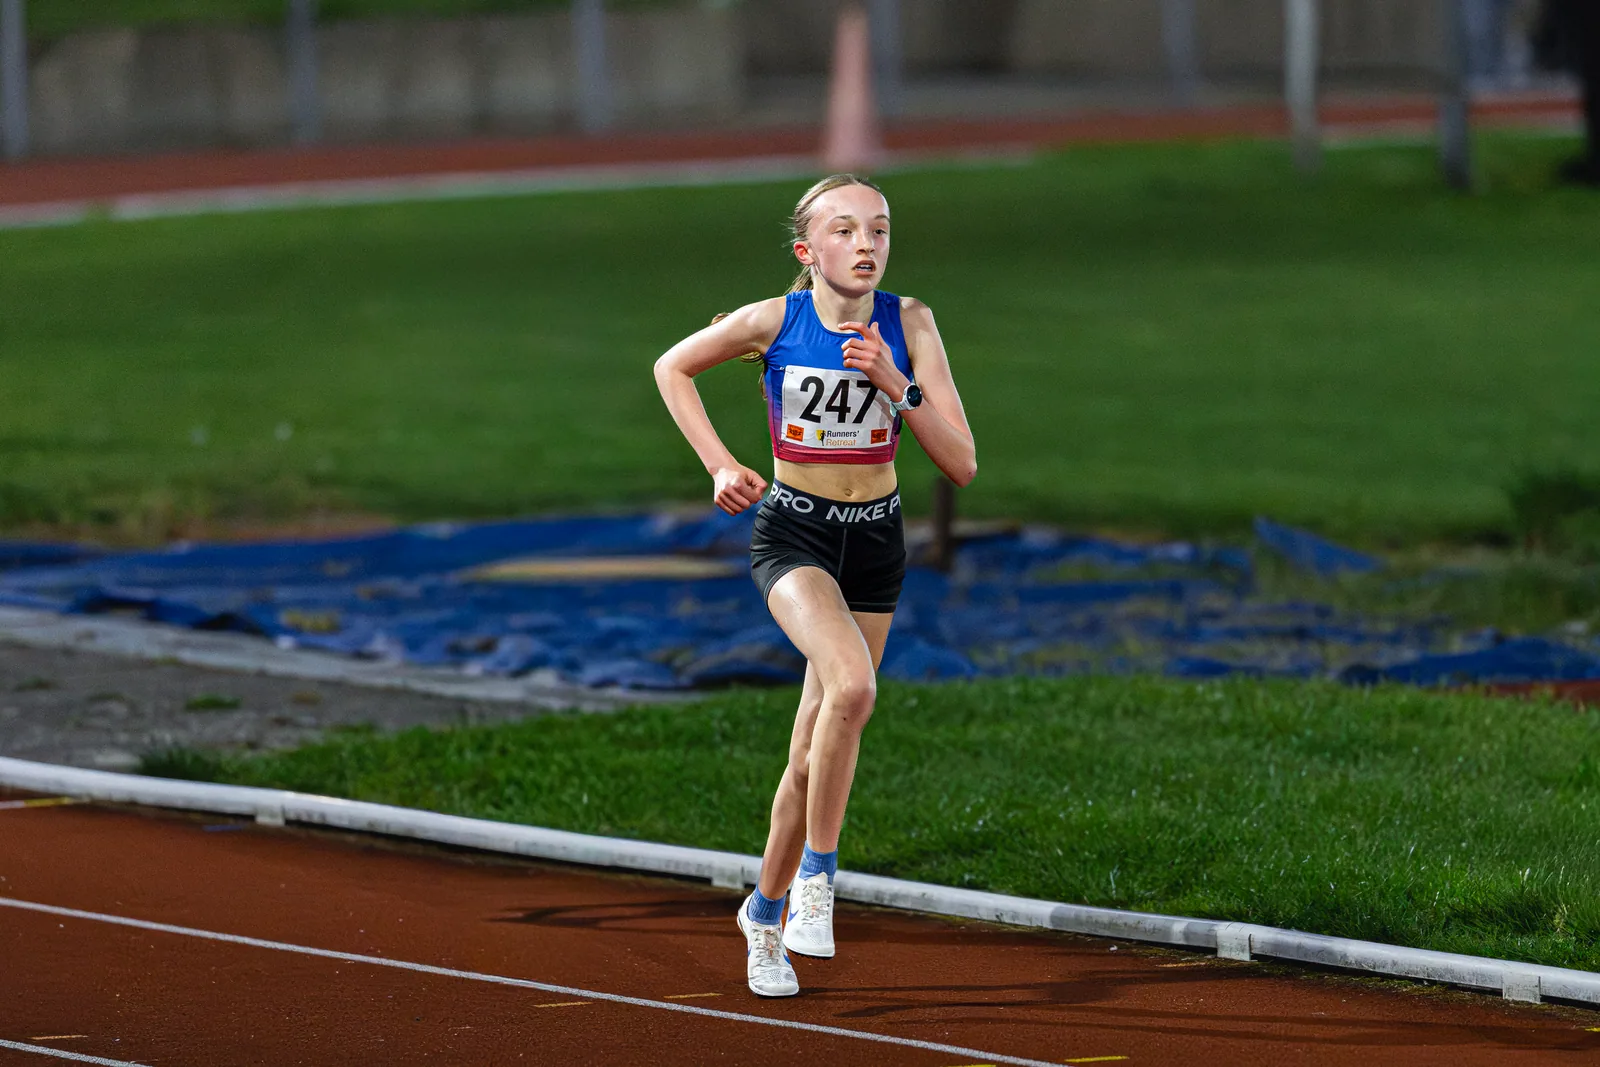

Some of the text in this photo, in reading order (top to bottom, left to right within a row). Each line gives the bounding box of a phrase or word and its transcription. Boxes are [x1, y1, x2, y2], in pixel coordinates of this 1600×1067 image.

[800, 376, 878, 423] 247
[771, 483, 814, 513] PRO
[826, 501, 887, 522] NIKE
